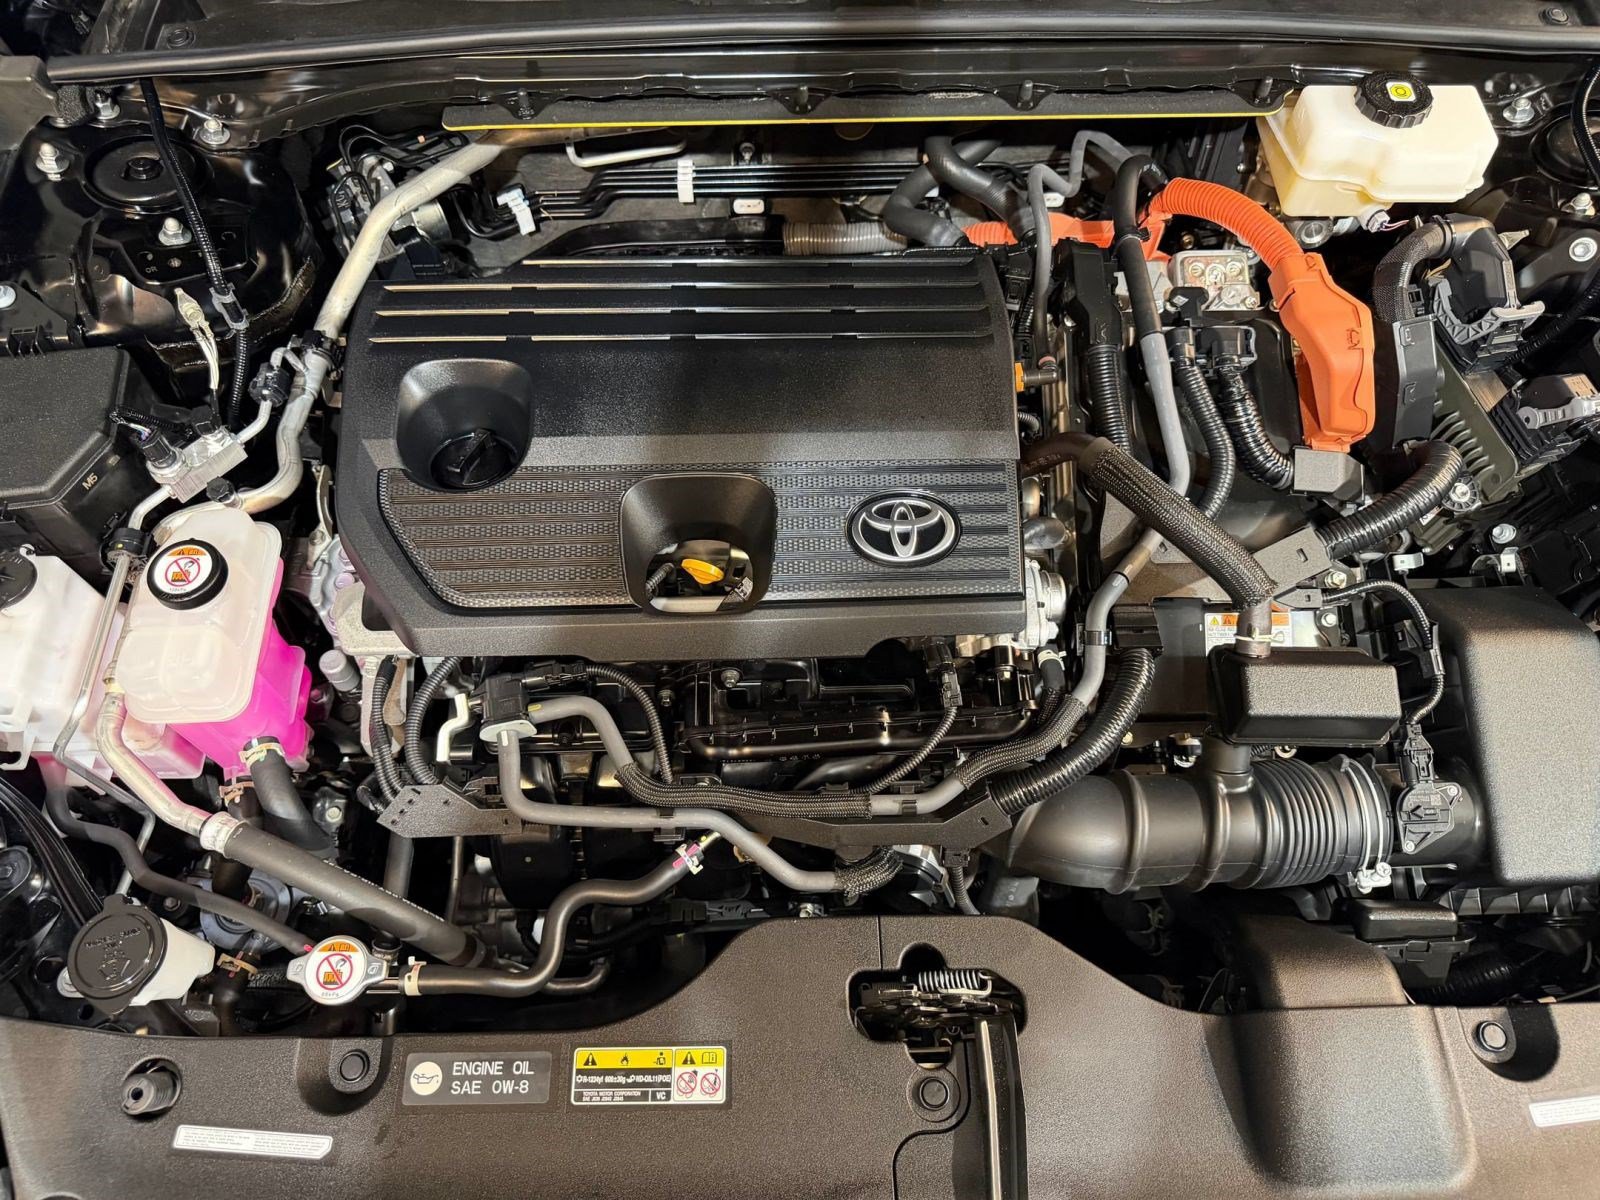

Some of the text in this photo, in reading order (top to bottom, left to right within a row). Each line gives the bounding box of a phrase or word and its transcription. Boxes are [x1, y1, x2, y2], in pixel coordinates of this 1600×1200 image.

[82, 472, 98, 490] M5
[452, 1060, 535, 1076] ENGINE OIL
[450, 1080, 482, 1094] SAE
[656, 1091, 666, 1100] VC
